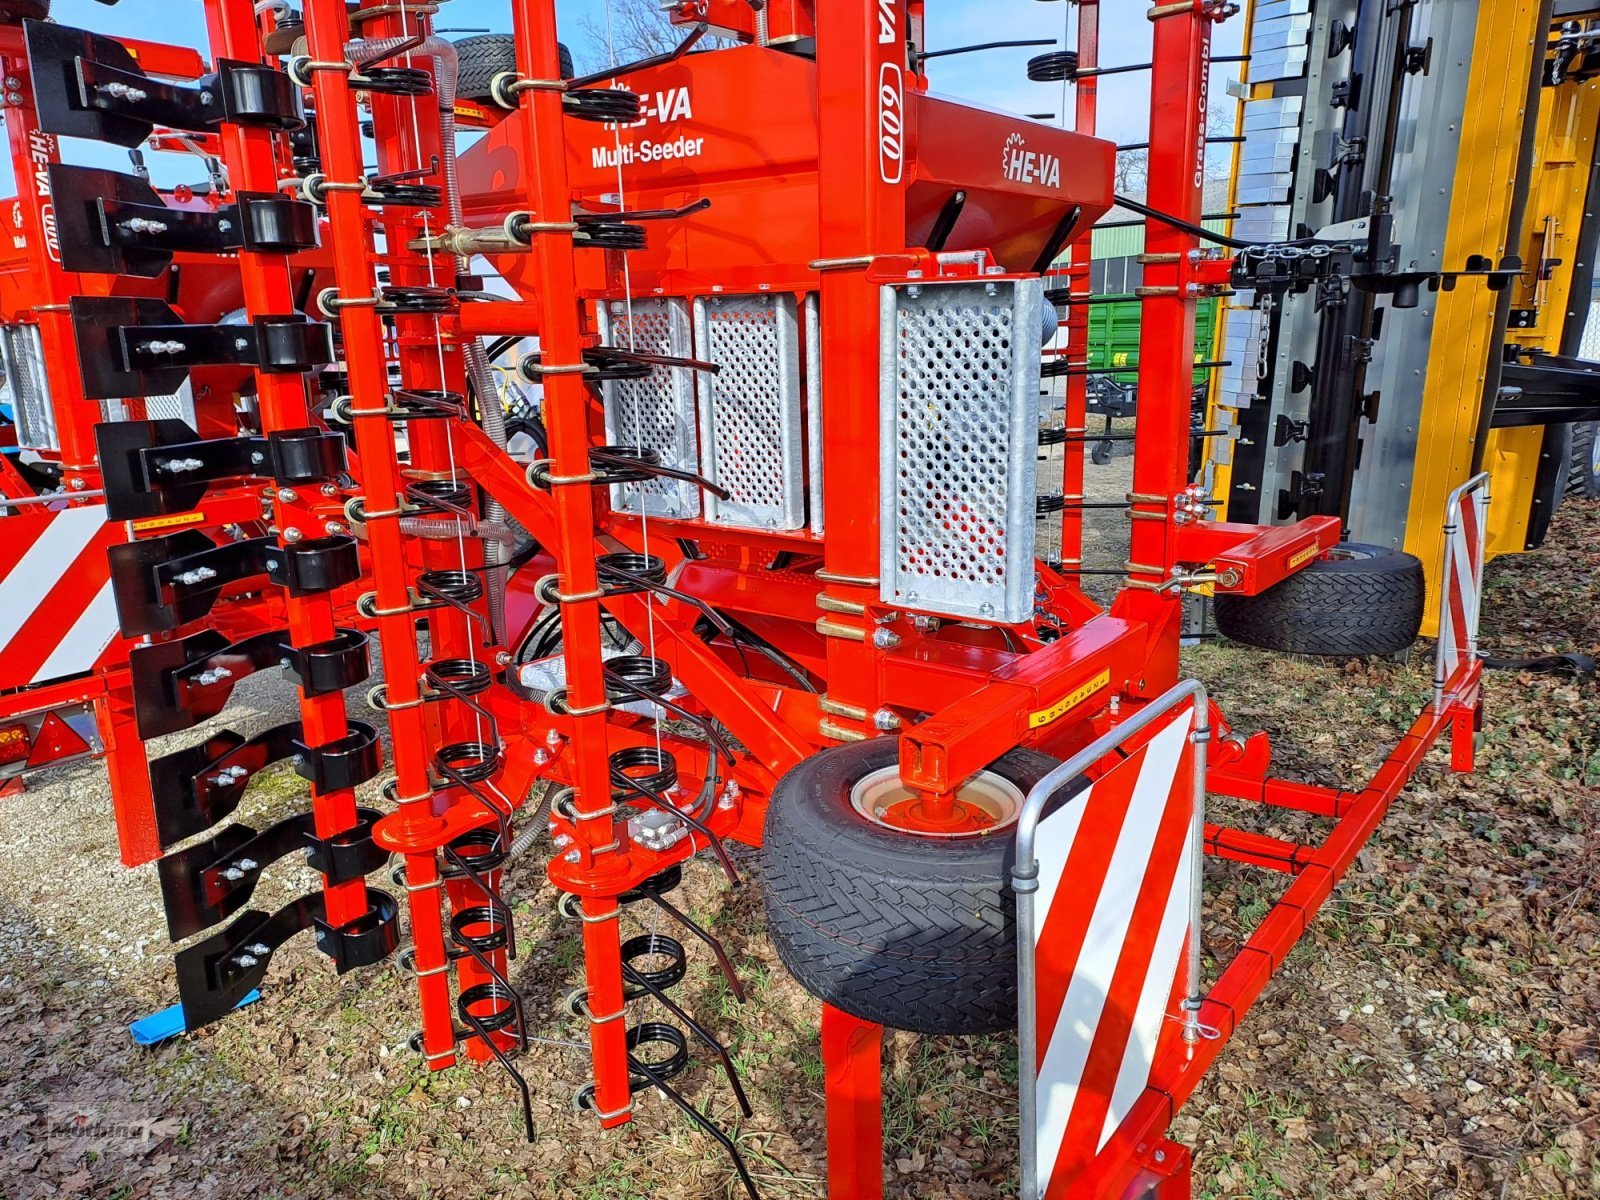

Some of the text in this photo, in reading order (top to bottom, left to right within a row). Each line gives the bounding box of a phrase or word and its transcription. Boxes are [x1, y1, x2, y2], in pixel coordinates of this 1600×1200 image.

[609, 86, 693, 131] E-VA
[882, 84, 901, 161] 600
[1194, 37, 1210, 189] Grass-Combi
[30, 132, 51, 196] HE-VA
[591, 135, 704, 169] Multi-Seeder
[1007, 148, 1060, 189] HE-VA
